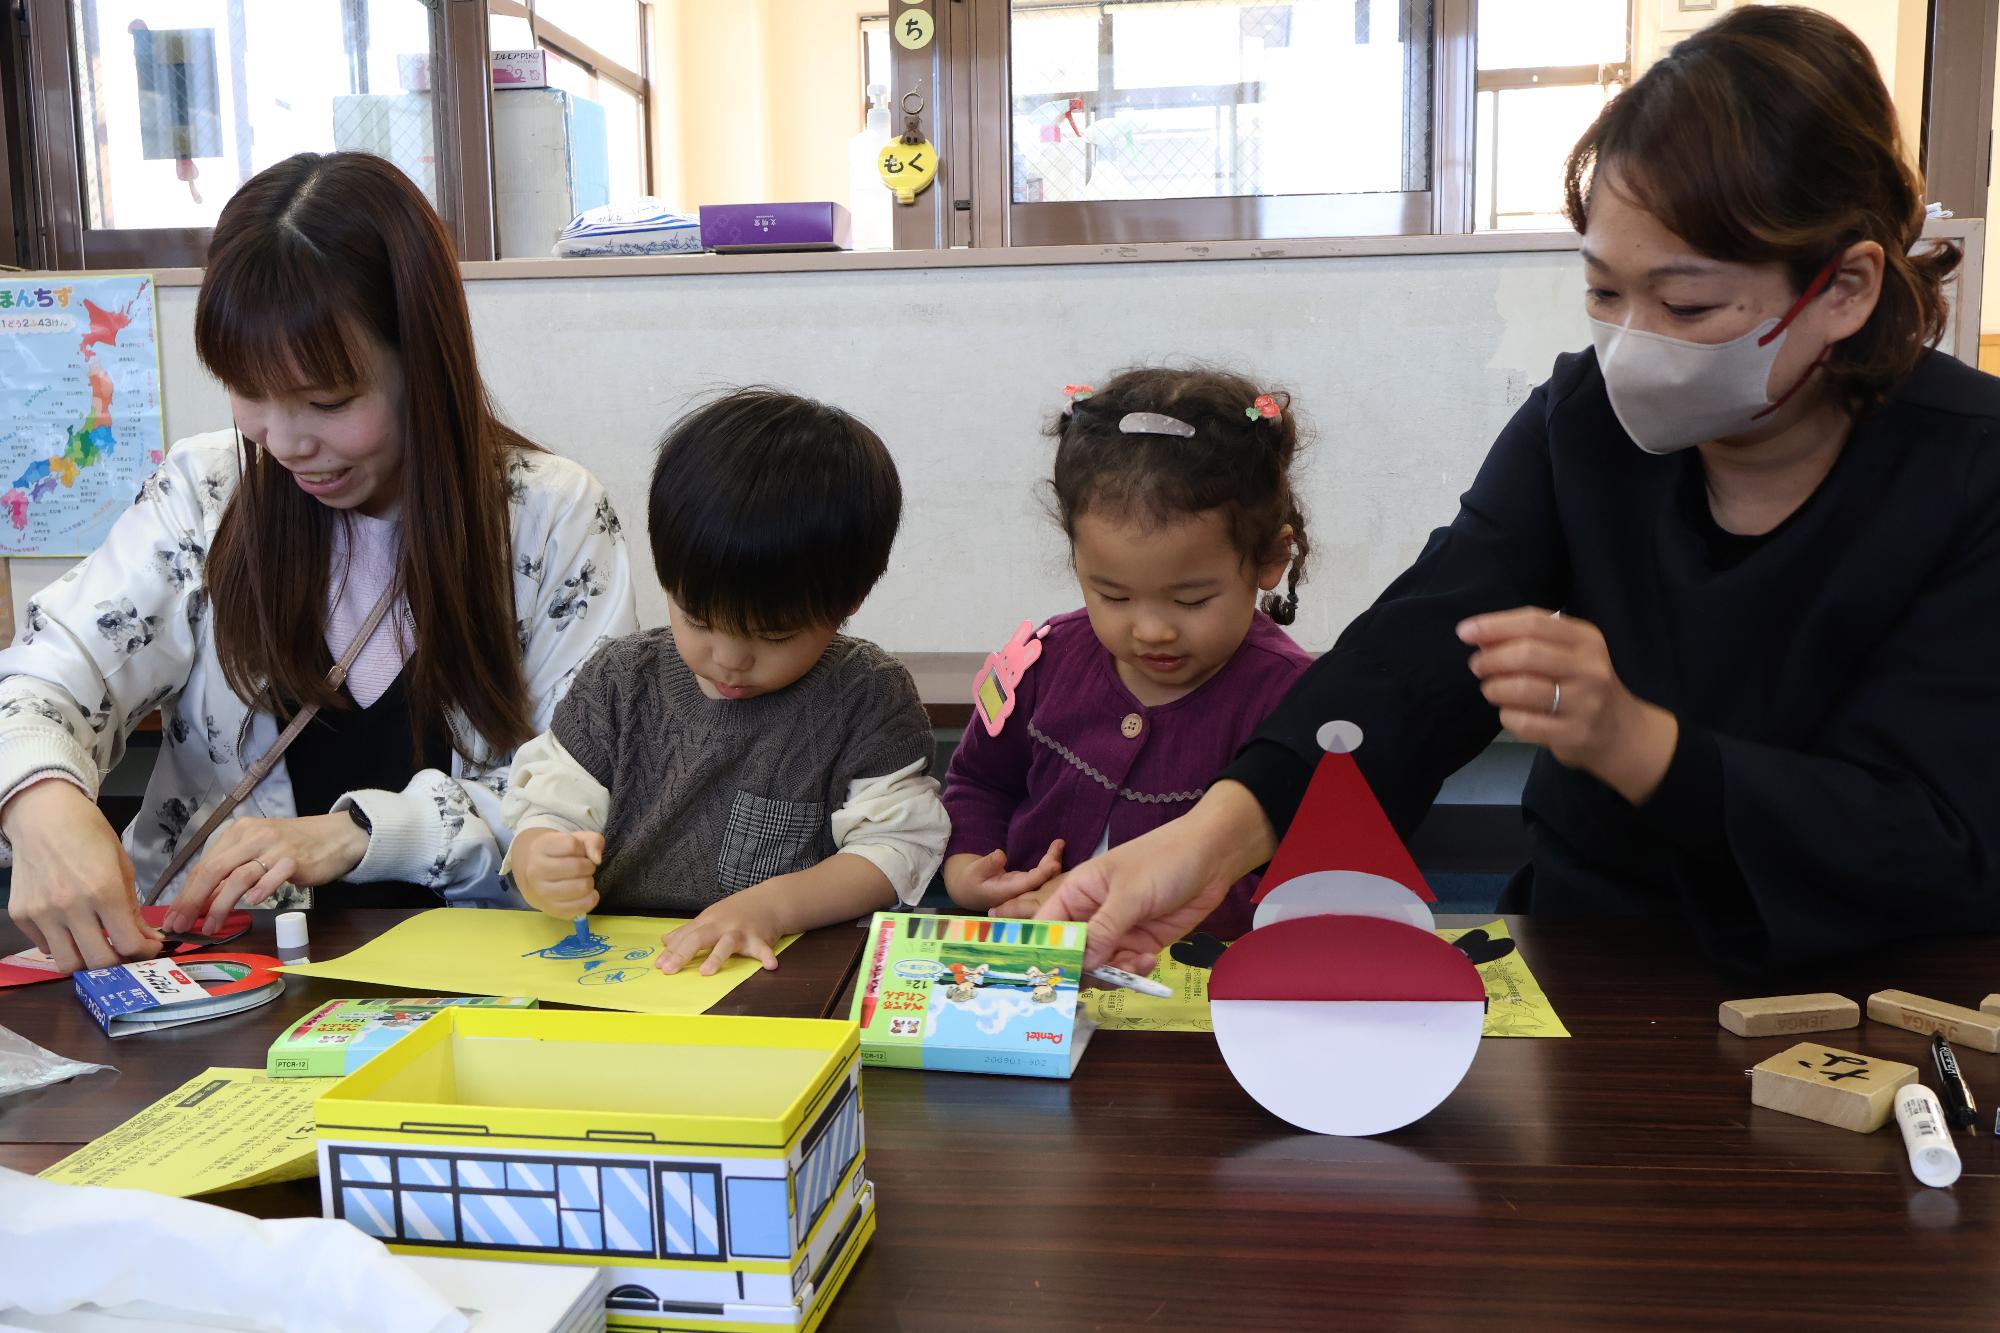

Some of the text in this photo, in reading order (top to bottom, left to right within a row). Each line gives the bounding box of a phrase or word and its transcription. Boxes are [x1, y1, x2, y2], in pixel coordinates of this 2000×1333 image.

[905, 18, 923, 41] ち
[883, 152, 924, 174] もく
[883, 991, 927, 1002] くれよん
[883, 1001, 925, 1011] ぺんてる
[1777, 1014, 1830, 1031] JENGA
[1902, 1013, 1959, 1037] JENGA
[1025, 1031, 1062, 1044] Pentel
